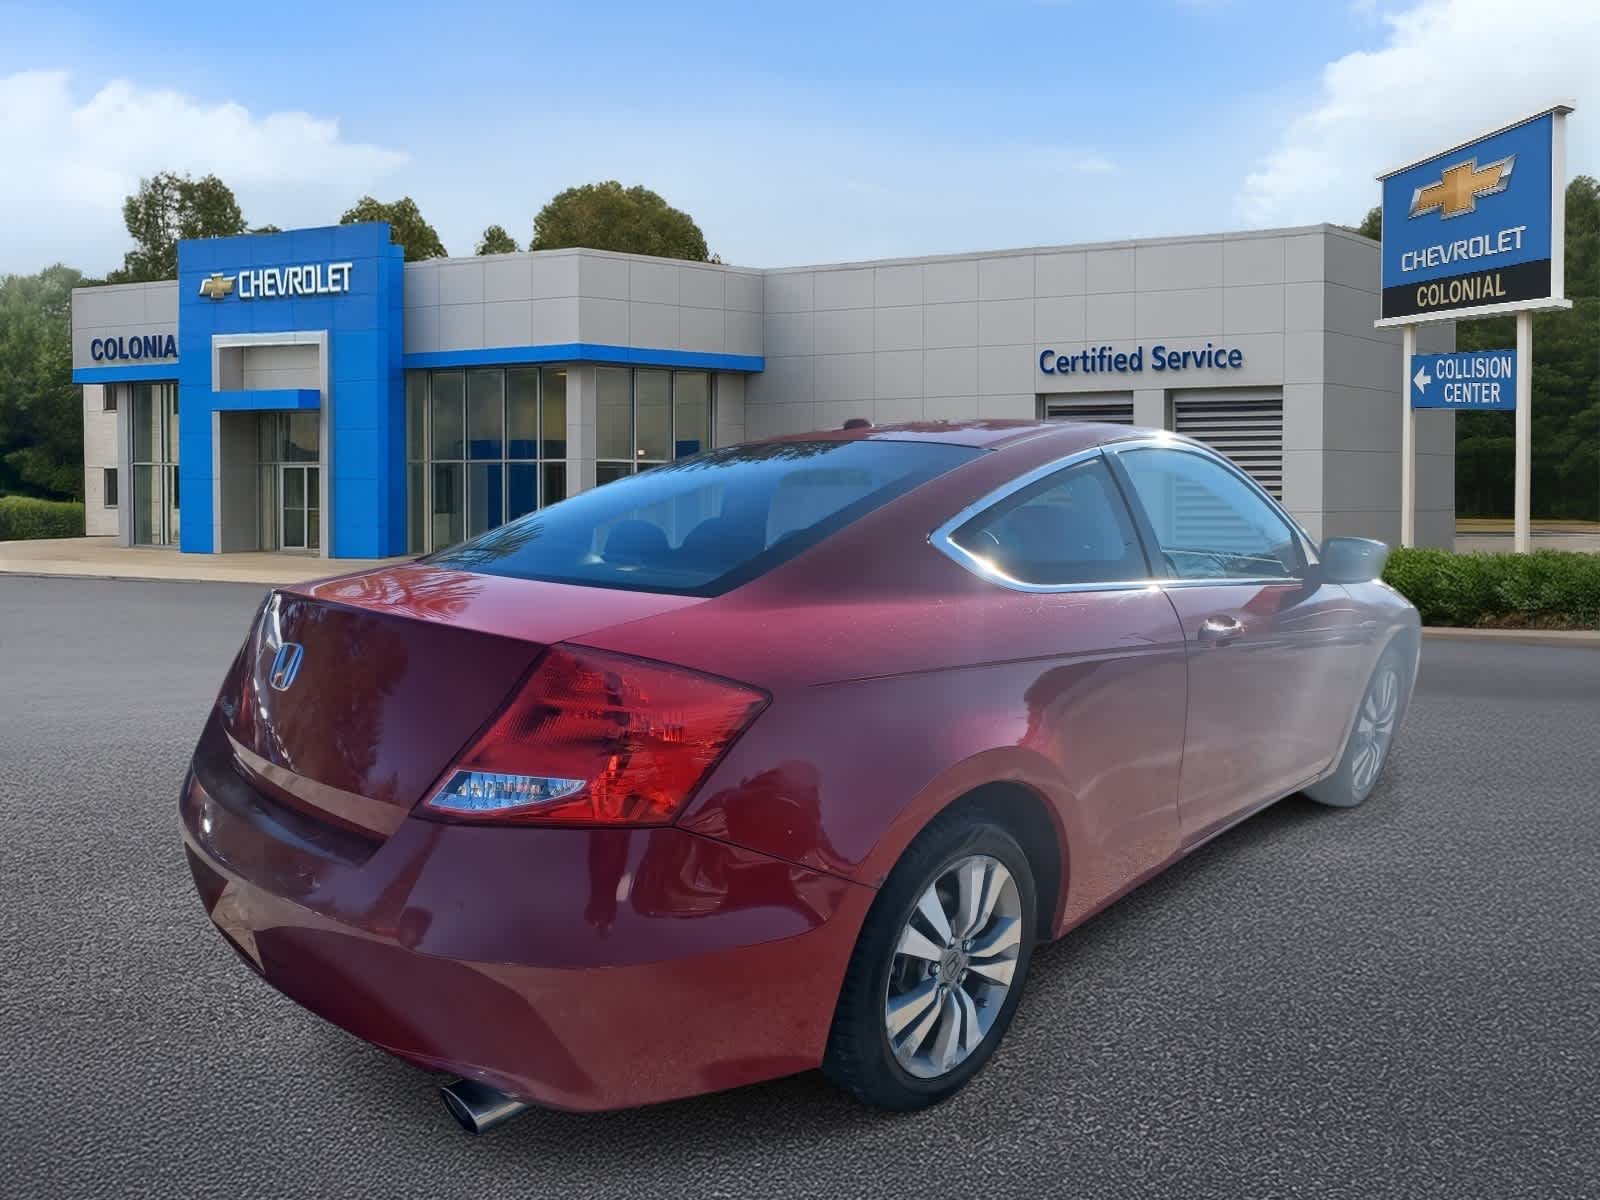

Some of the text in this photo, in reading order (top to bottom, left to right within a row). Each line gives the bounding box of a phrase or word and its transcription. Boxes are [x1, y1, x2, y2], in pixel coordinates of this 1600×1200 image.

[1401, 225, 1527, 272] CHEVROLET
[238, 262, 353, 298] CHEVROLET
[1417, 273, 1506, 307] COLONIAL
[91, 334, 179, 361] COLONIA
[1039, 343, 1243, 374] Certified Service
[1436, 357, 1512, 379] COLLISION
[1444, 382, 1500, 403] CENTER
